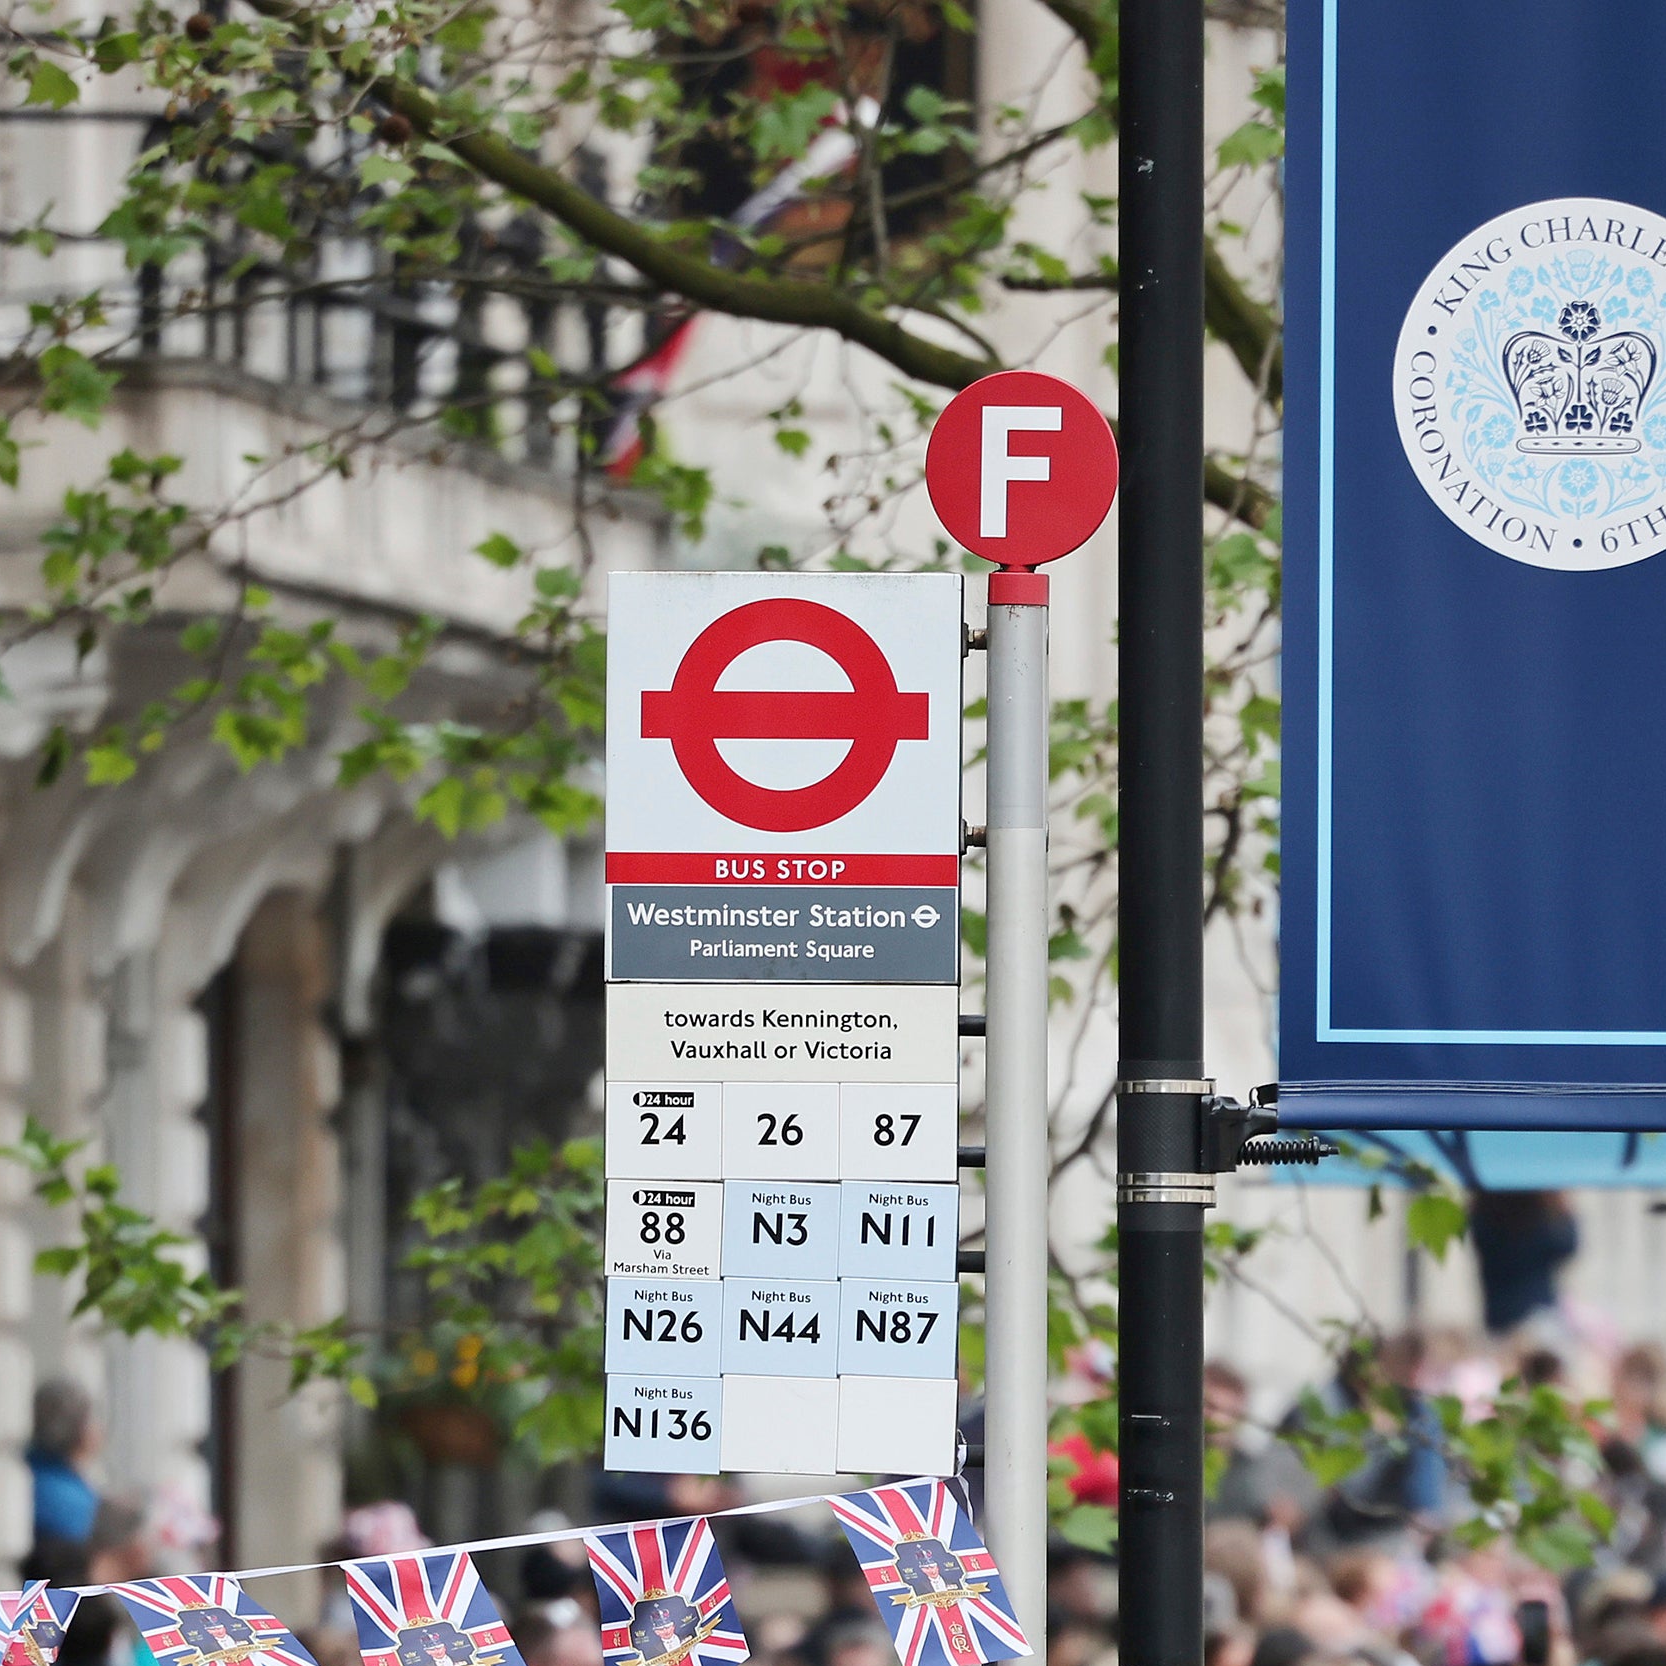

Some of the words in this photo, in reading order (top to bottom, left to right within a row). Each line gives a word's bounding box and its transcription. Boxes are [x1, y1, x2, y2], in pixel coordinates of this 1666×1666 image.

[1432, 238, 1513, 318] KING
[1409, 350, 1558, 553] CORONATION
[980, 406, 1062, 538] F
[715, 858, 765, 879] BUS
[777, 859, 846, 880] STOP
[627, 902, 800, 927] Westminster
[809, 904, 906, 928] Station
[690, 939, 799, 958] Parliament
[805, 940, 875, 962] Square
[664, 1009, 755, 1029] towards
[762, 1009, 899, 1033] Kennington,
[670, 1041, 767, 1060] Vauxhall
[774, 1045, 797, 1060] or
[804, 1041, 892, 1061] Victoria
[646, 1093, 662, 1106] 24
[664, 1093, 693, 1106] hour
[640, 1114, 687, 1146] 24
[757, 1113, 804, 1146] 26
[873, 1114, 922, 1146] 87
[646, 1192, 662, 1205] 24
[664, 1192, 694, 1206] hour
[752, 1192, 786, 1206] Night
[789, 1194, 812, 1206] Bus
[869, 1193, 904, 1207] Night
[907, 1195, 930, 1207] Bus
[640, 1212, 686, 1244] 88
[753, 1212, 808, 1246] N3
[861, 1213, 935, 1247] N11
[653, 1249, 672, 1261] Via
[614, 1263, 670, 1275] Marsham
[673, 1263, 710, 1276] Street
[634, 1290, 668, 1303] Night
[670, 1290, 694, 1302] Bus
[751, 1290, 786, 1304] Night
[789, 1291, 812, 1303] Bus
[869, 1291, 904, 1305] Night
[906, 1292, 929, 1304] Bus
[623, 1310, 703, 1343] N26
[739, 1310, 821, 1344] N44
[856, 1311, 939, 1344] N87
[634, 1386, 668, 1400] Night
[670, 1387, 694, 1399] Bus
[613, 1407, 712, 1441] N136
